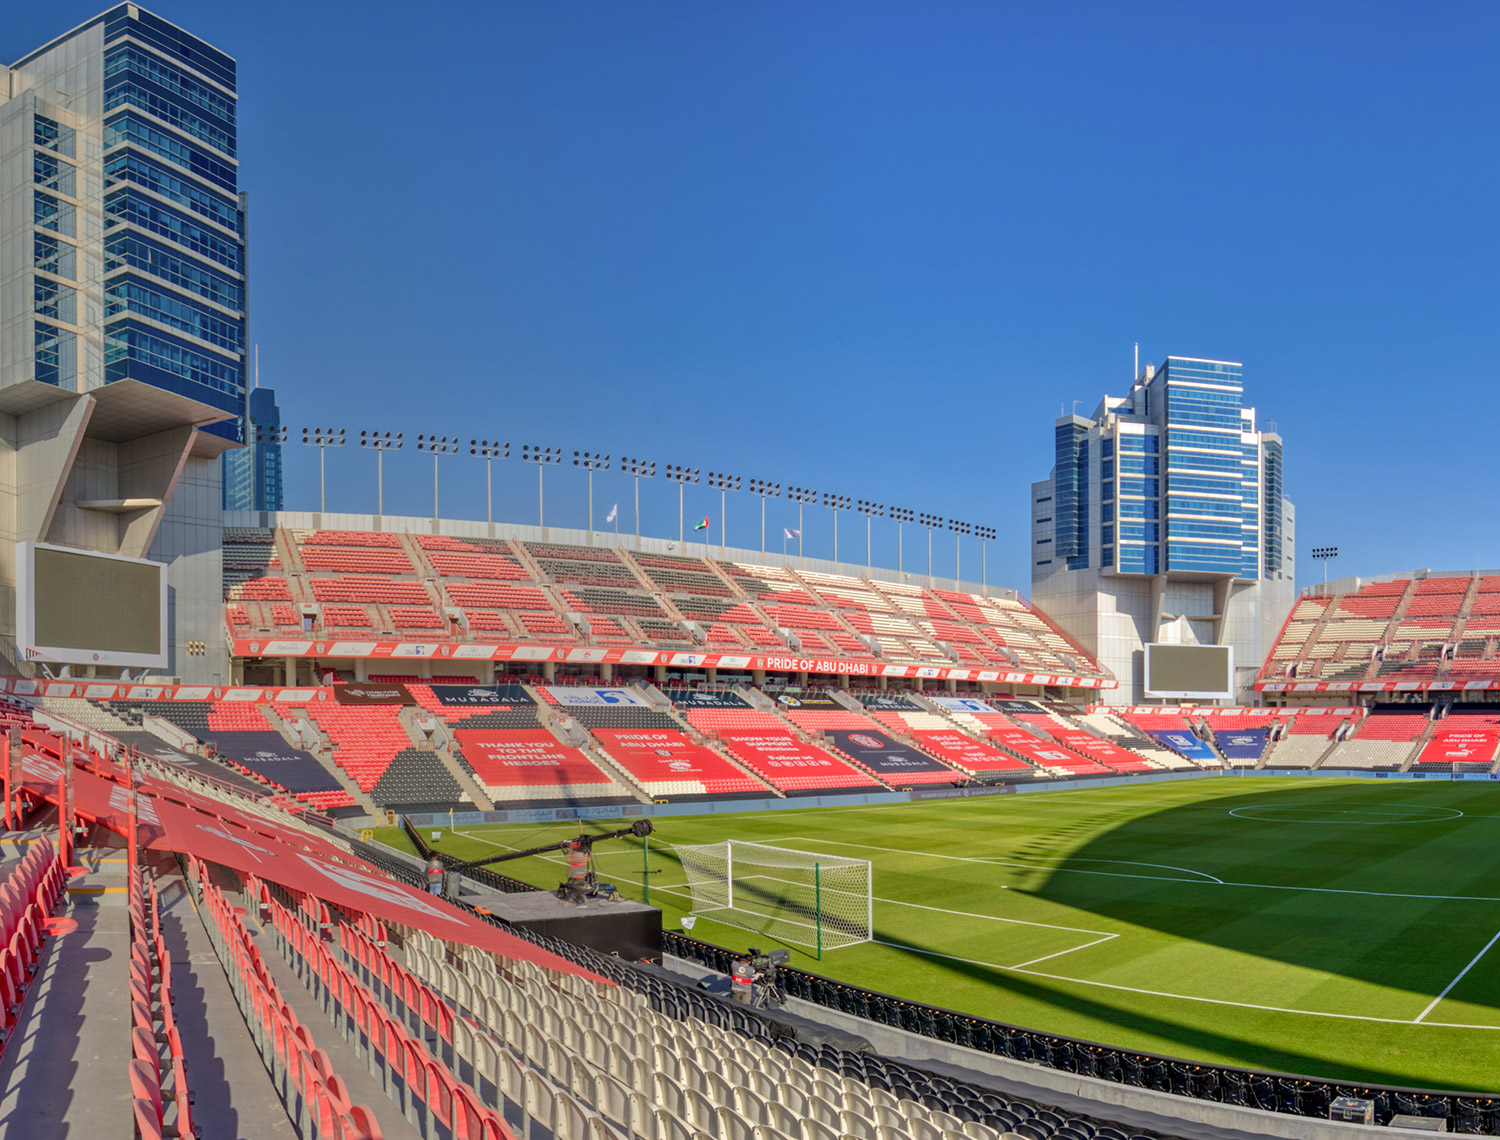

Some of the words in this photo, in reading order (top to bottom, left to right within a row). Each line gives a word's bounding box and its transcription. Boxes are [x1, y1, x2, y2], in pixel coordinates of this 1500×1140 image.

[767, 657, 798, 670] PRIDE
[799, 660, 814, 671] OF
[815, 661, 837, 672] ABU
[838, 662, 869, 674] DHABI
